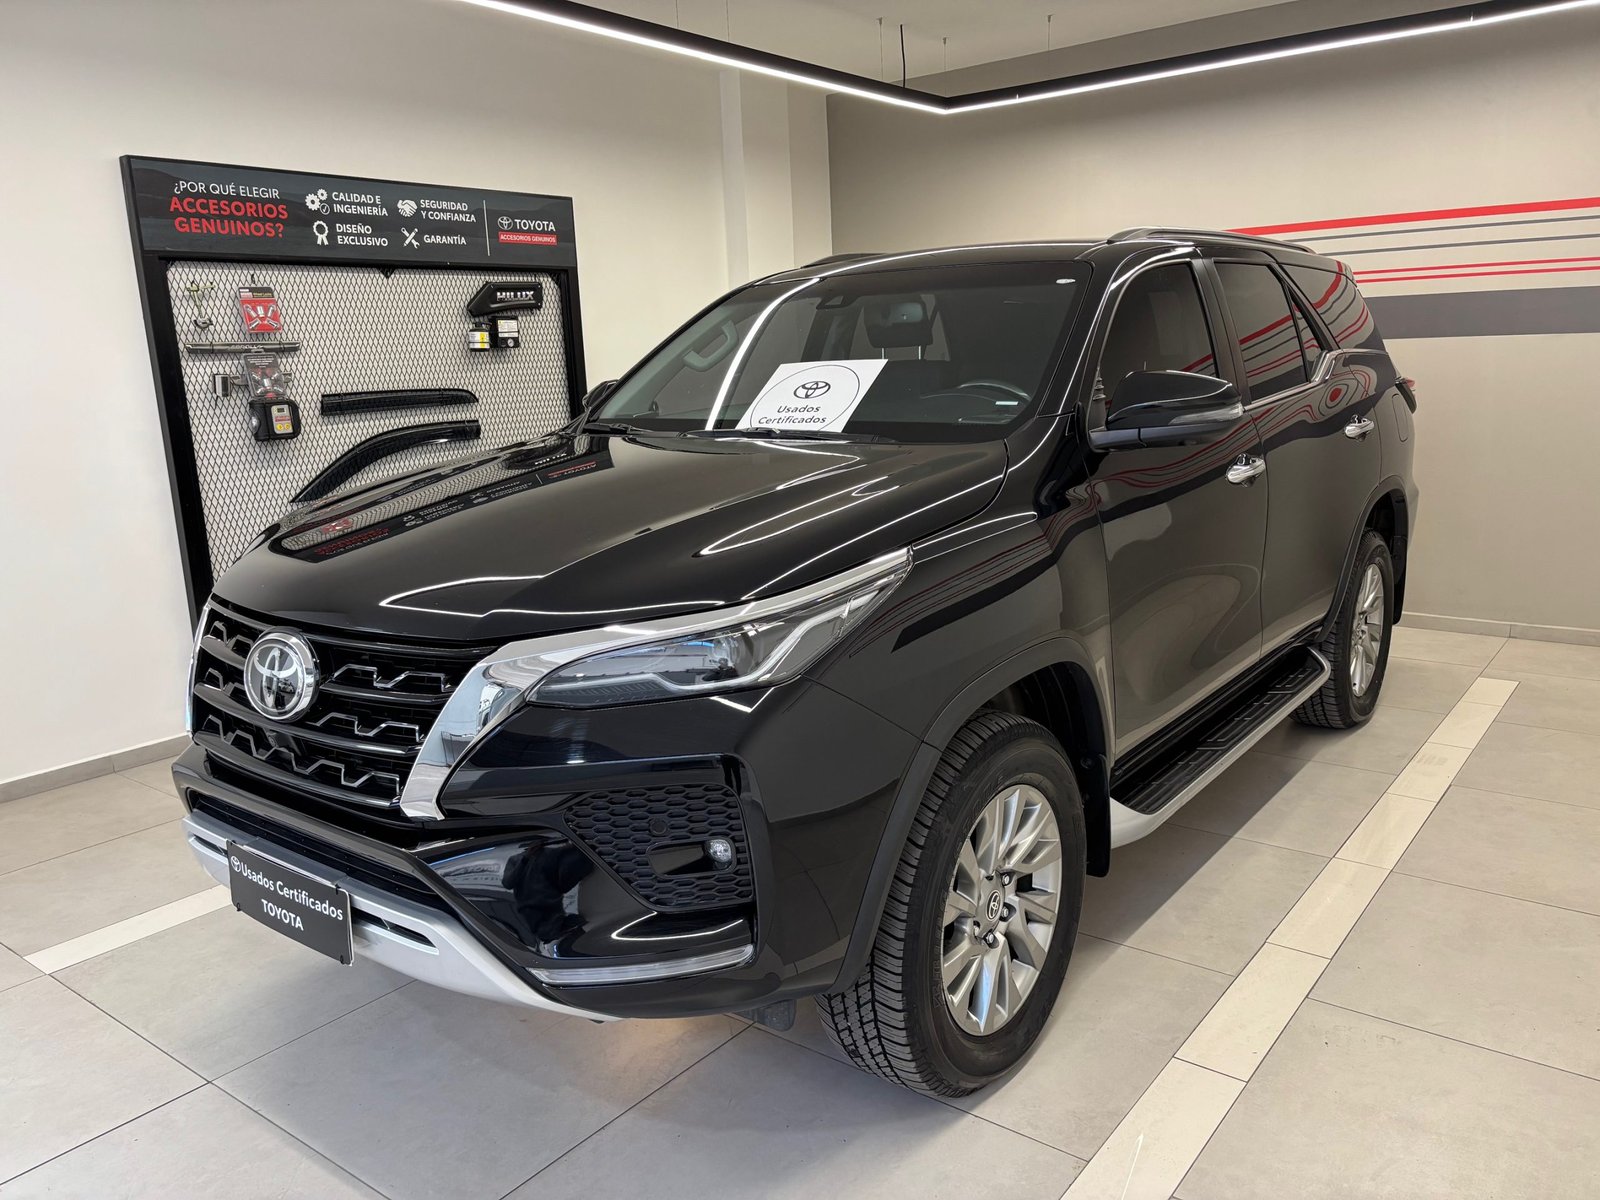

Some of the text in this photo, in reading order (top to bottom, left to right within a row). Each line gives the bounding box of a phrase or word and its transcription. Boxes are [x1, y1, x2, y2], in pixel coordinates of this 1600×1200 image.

[174, 181, 280, 199] ¿POR QUÉ ELEGIR
[332, 191, 381, 204] CALIDAD E
[169, 196, 289, 219] ACCESORIOS
[333, 203, 388, 216] INGENIERÍA
[420, 199, 468, 211] SEGURIDAD
[421, 210, 476, 223] Y CONFIANZA
[174, 217, 284, 238] GENUINOS?
[335, 223, 372, 235] DISEÑO
[514, 219, 556, 232] TOYOTA
[337, 235, 389, 247] EXCLUSIVO
[423, 234, 467, 245] GARANTÍA
[496, 291, 535, 301] HILUX
[777, 404, 821, 413] Usados
[758, 415, 826, 424] Certificados
[241, 862, 344, 920] Usados Certificados
[261, 899, 305, 932] TOYOTA
